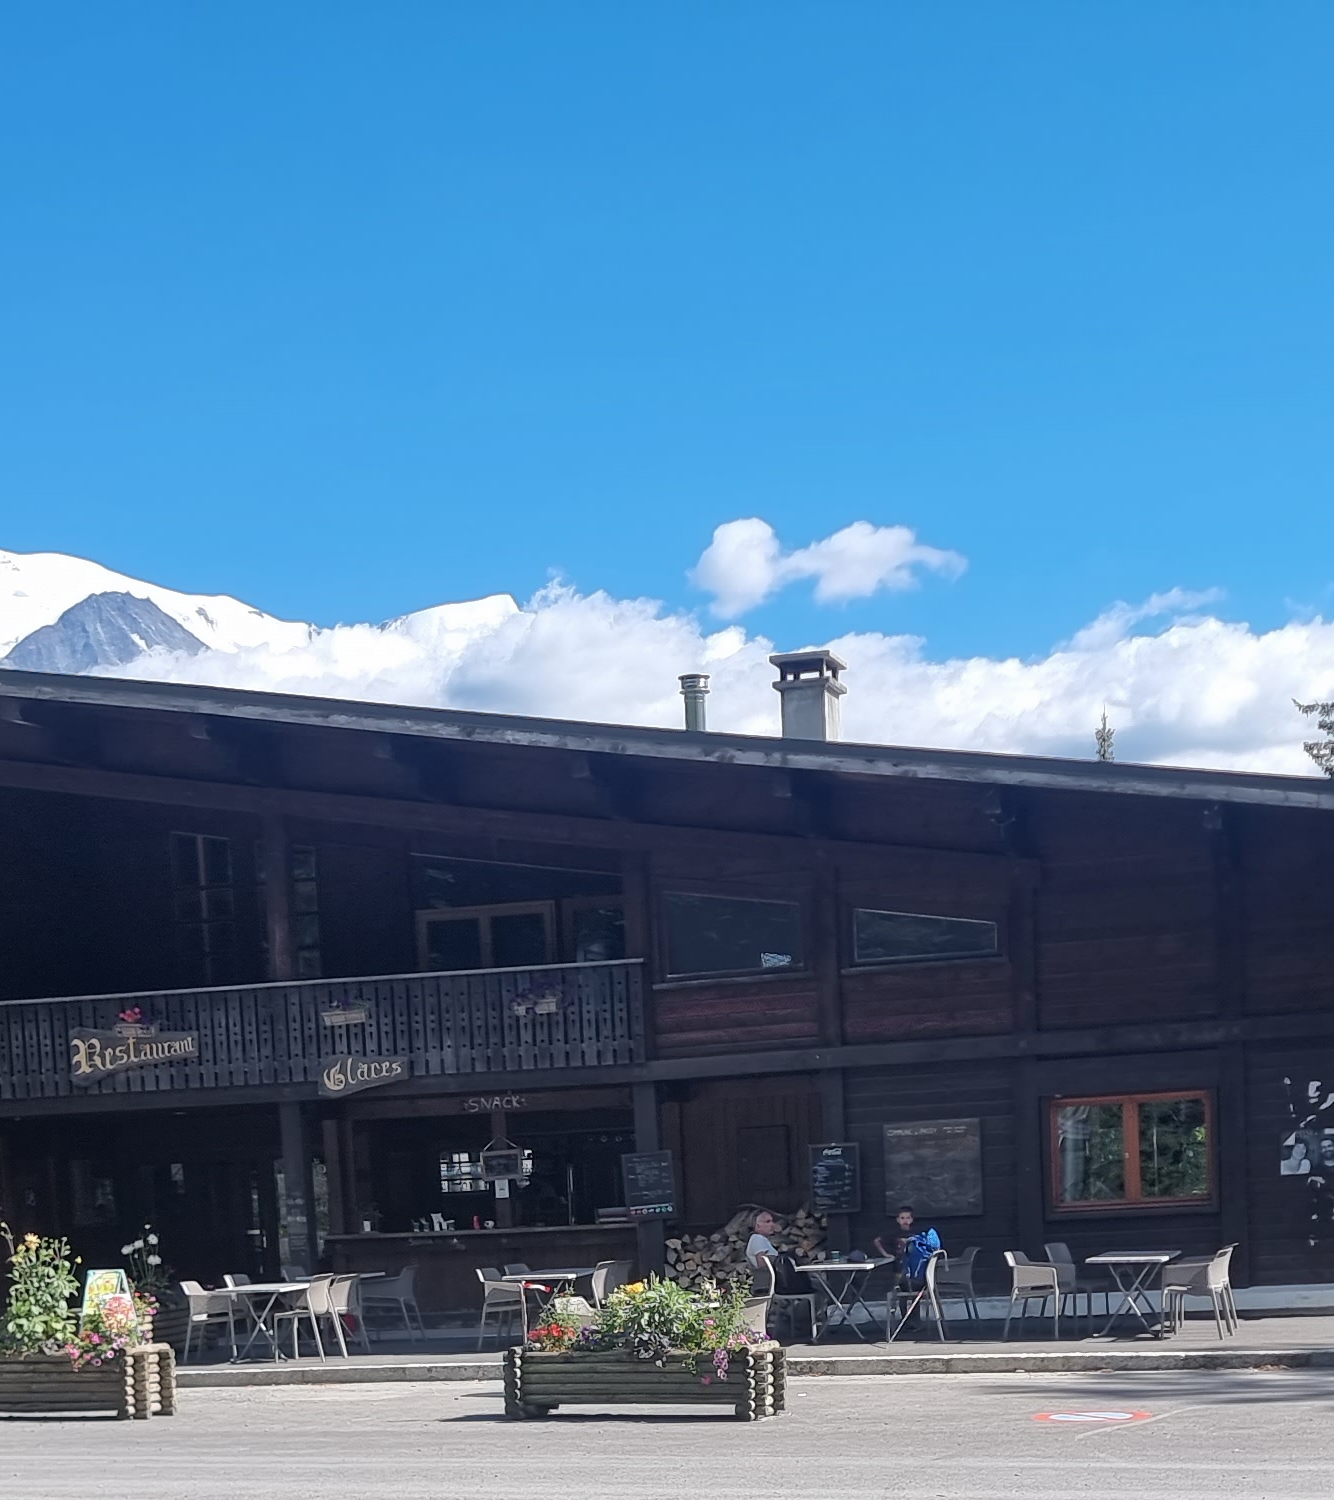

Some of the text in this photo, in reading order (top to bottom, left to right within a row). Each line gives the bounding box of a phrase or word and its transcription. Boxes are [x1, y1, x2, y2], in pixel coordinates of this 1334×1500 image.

[70, 1036, 196, 1076] Restaurant
[323, 1057, 402, 1091] Glaces
[467, 1094, 521, 1113] SNACK
